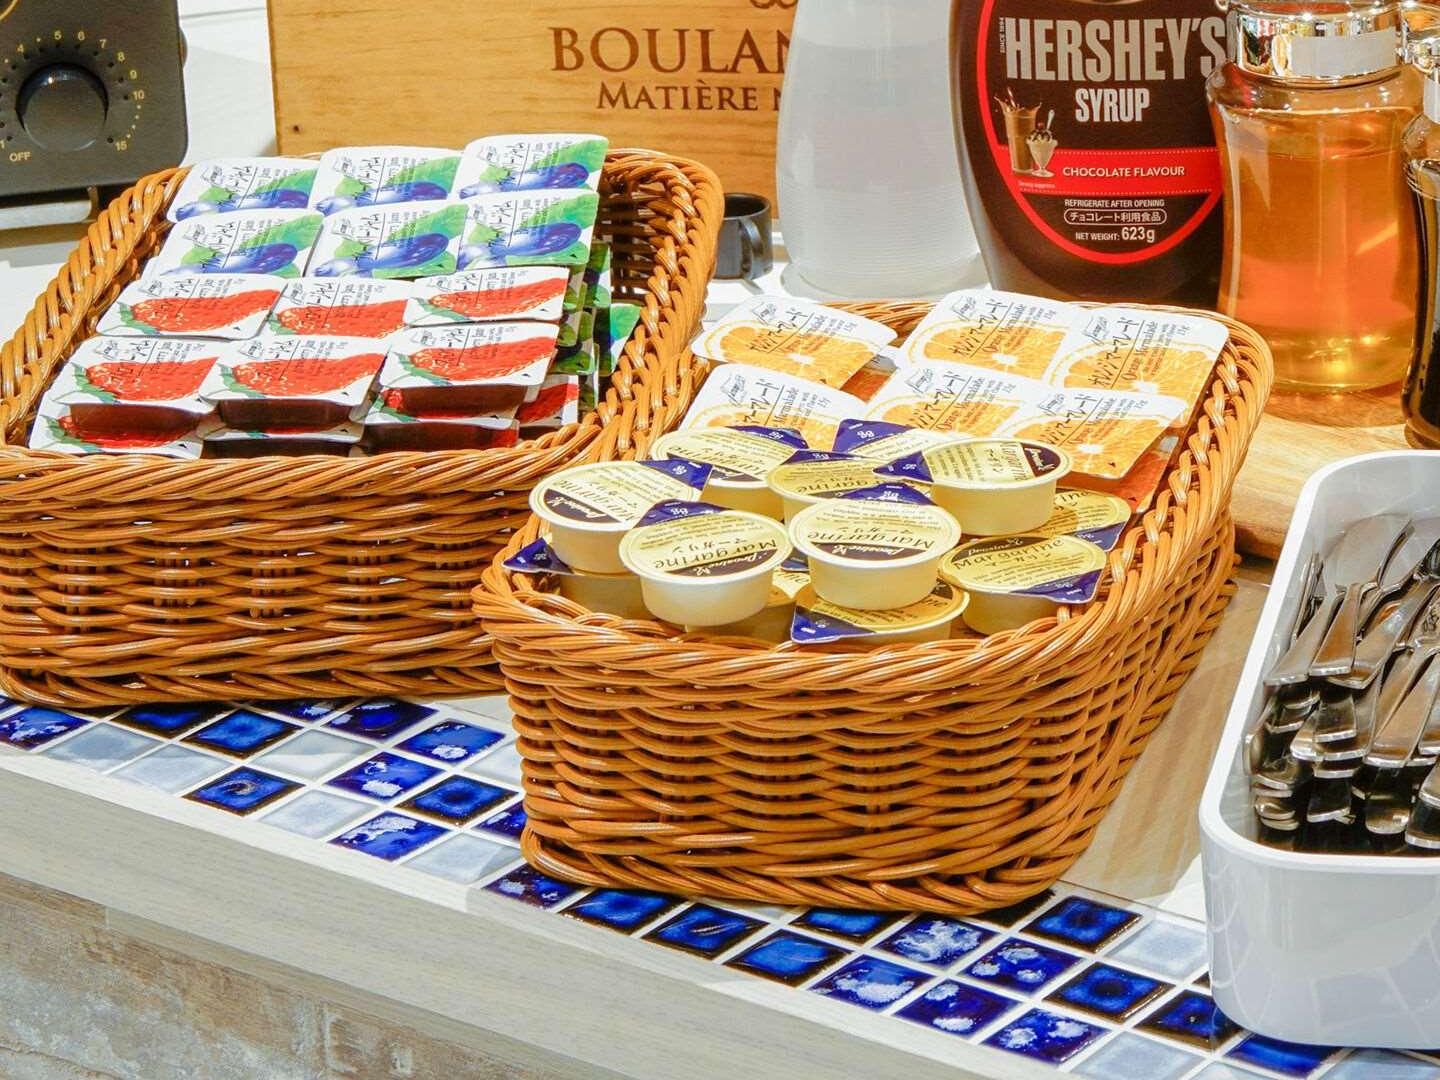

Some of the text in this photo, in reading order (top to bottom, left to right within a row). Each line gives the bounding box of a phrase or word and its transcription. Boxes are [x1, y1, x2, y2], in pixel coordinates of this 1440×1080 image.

[54, 31, 62, 40] 5
[77, 31, 86, 41] 6
[99, 38, 107, 48] 7
[17, 44, 24, 53] 4
[1005, 16, 1227, 82] HERSHEY'S
[117, 52, 125, 61] 8
[129, 70, 137, 79] 9
[132, 90, 145, 100] 10
[597, 80, 758, 111] MATIÈRE
[1075, 87, 1150, 122] SYRUP
[115, 141, 128, 151] 15
[9, 152, 31, 162] OFF
[1062, 166, 1185, 177] CHOCOLATE FLAVOUR
[1064, 199, 1165, 207] REFRIGERATE AFTER OPENING
[1069, 211, 1162, 223] チョコレート利用食品
[1076, 226, 1155, 243] NET WEIGHT: 623g
[807, 530, 936, 550] Margarine
[654, 539, 777, 569] Margarine
[953, 538, 1065, 570] Margarine
